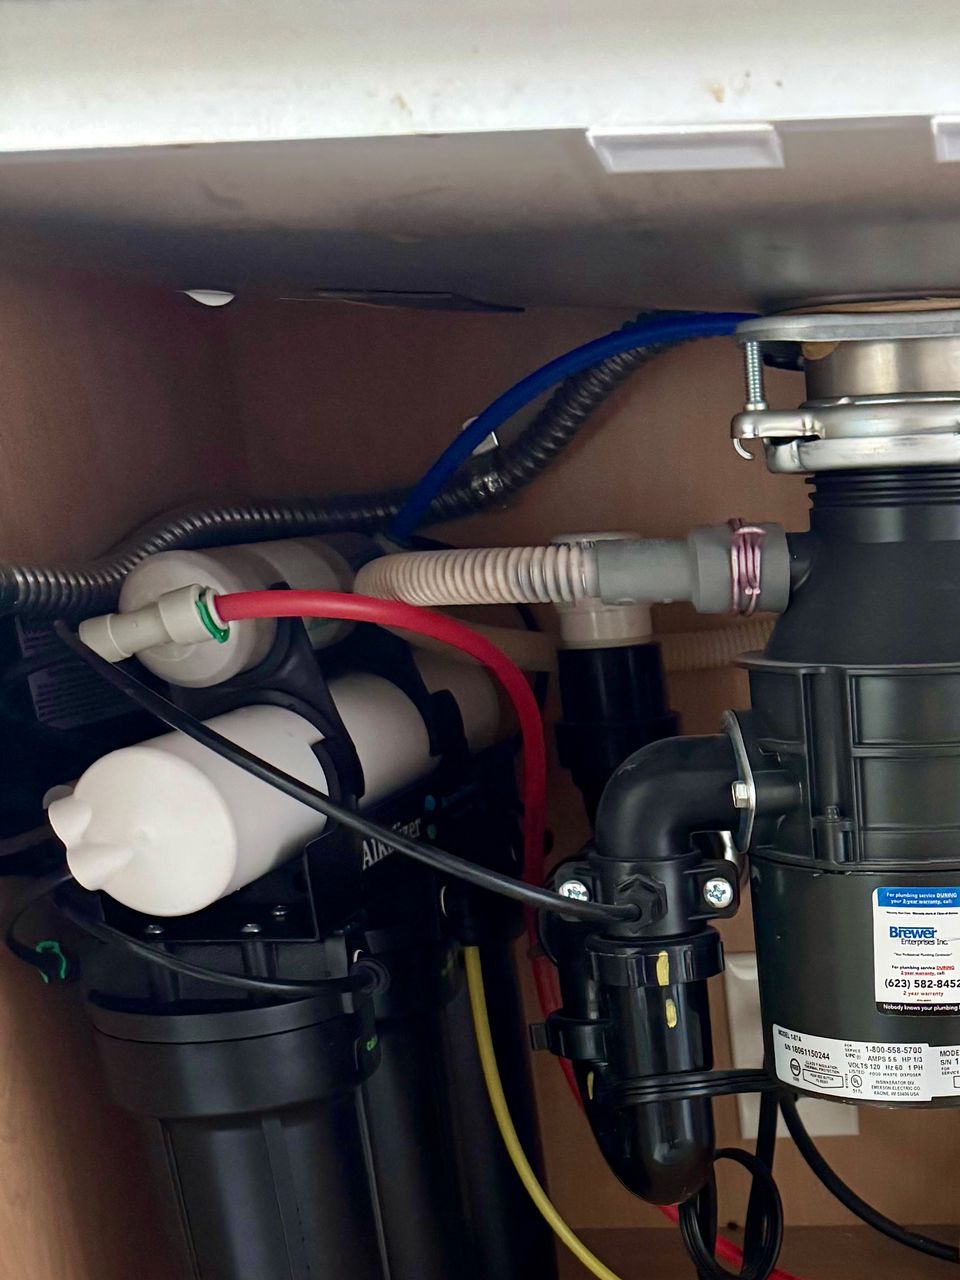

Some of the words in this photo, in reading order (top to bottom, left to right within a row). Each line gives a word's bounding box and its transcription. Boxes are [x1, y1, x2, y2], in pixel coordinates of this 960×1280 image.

[890, 926, 937, 938] Brewer
[901, 938, 935, 946] Enterprises
[937, 938, 948, 946] Inc.
[885, 978, 911, 989] (623)
[865, 1046, 922, 1054] 1-800-558-5700
